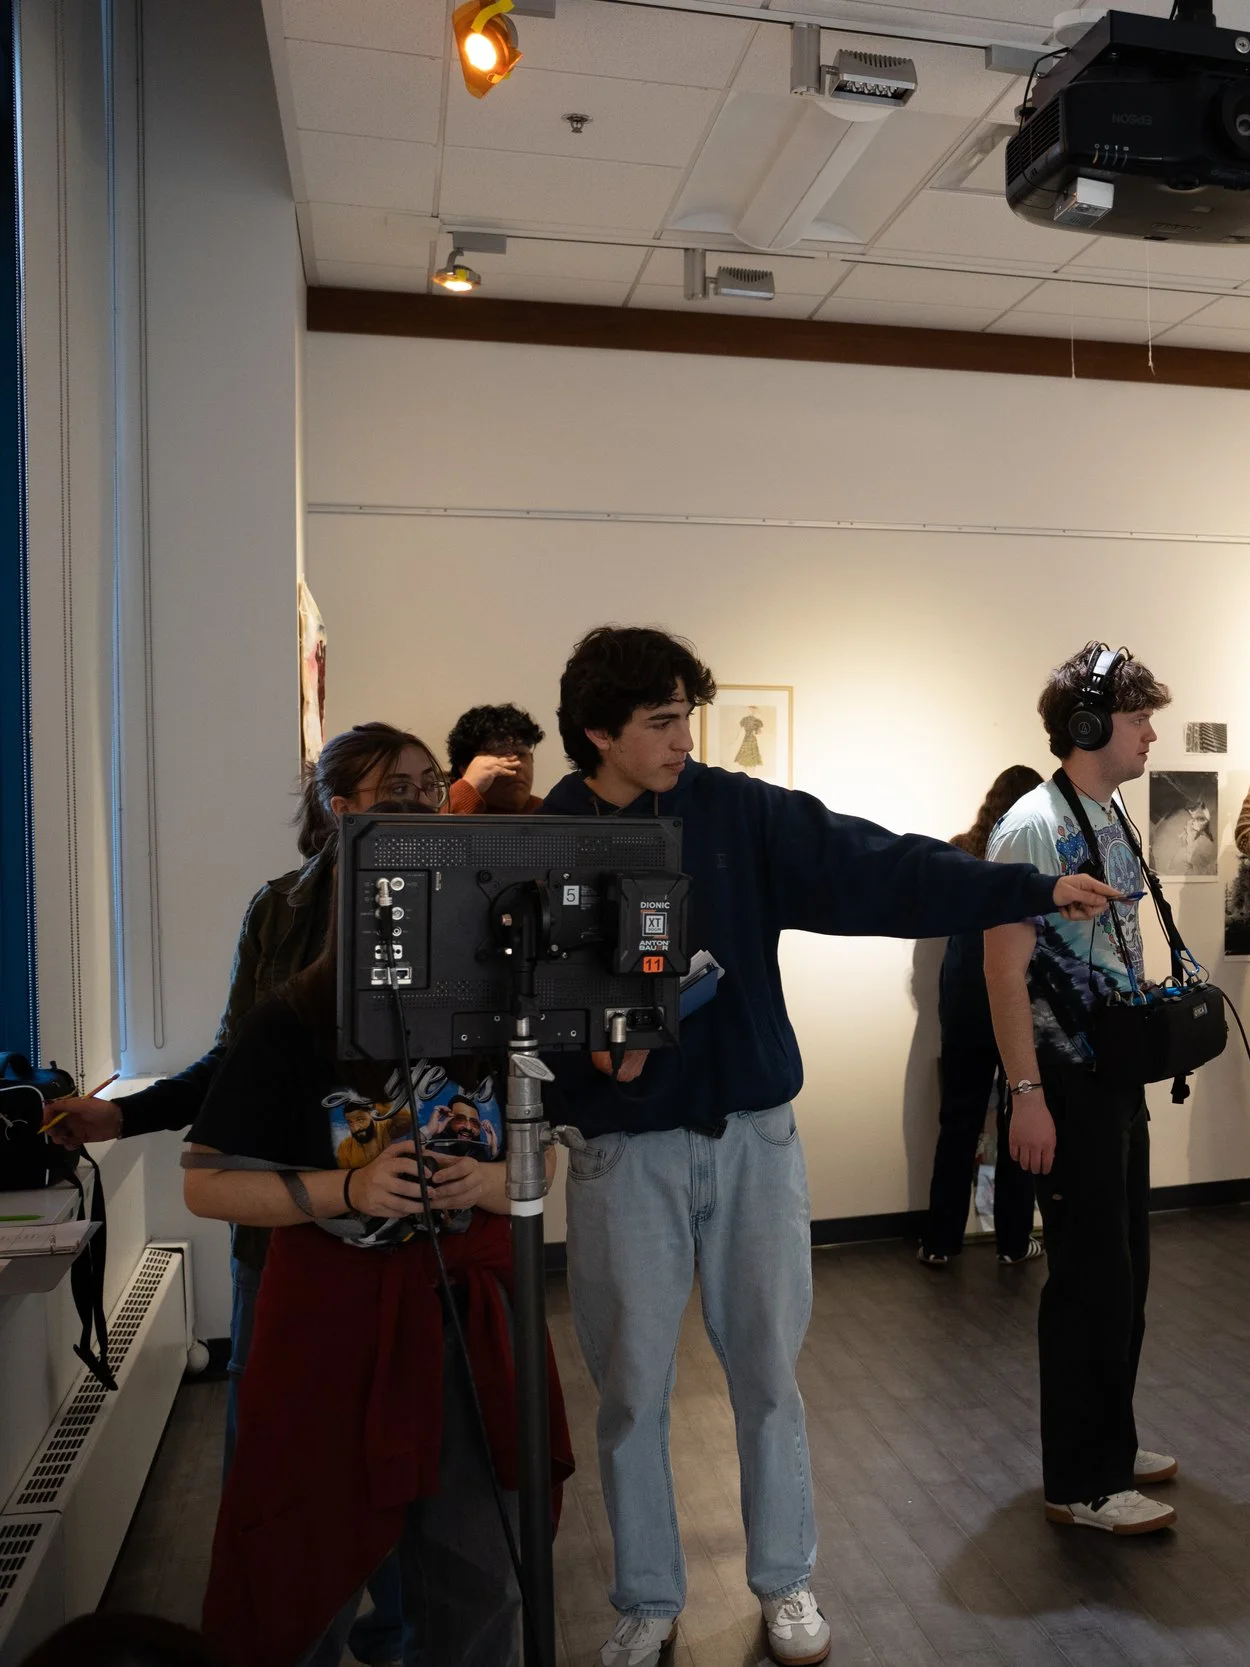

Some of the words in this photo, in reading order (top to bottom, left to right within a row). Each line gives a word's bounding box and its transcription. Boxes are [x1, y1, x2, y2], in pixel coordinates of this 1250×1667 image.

[1111, 112, 1153, 126] EPSON
[566, 888, 576, 902] 5
[640, 901, 670, 909] DIONIC
[648, 917, 661, 928] XT
[645, 958, 661, 971] 11
